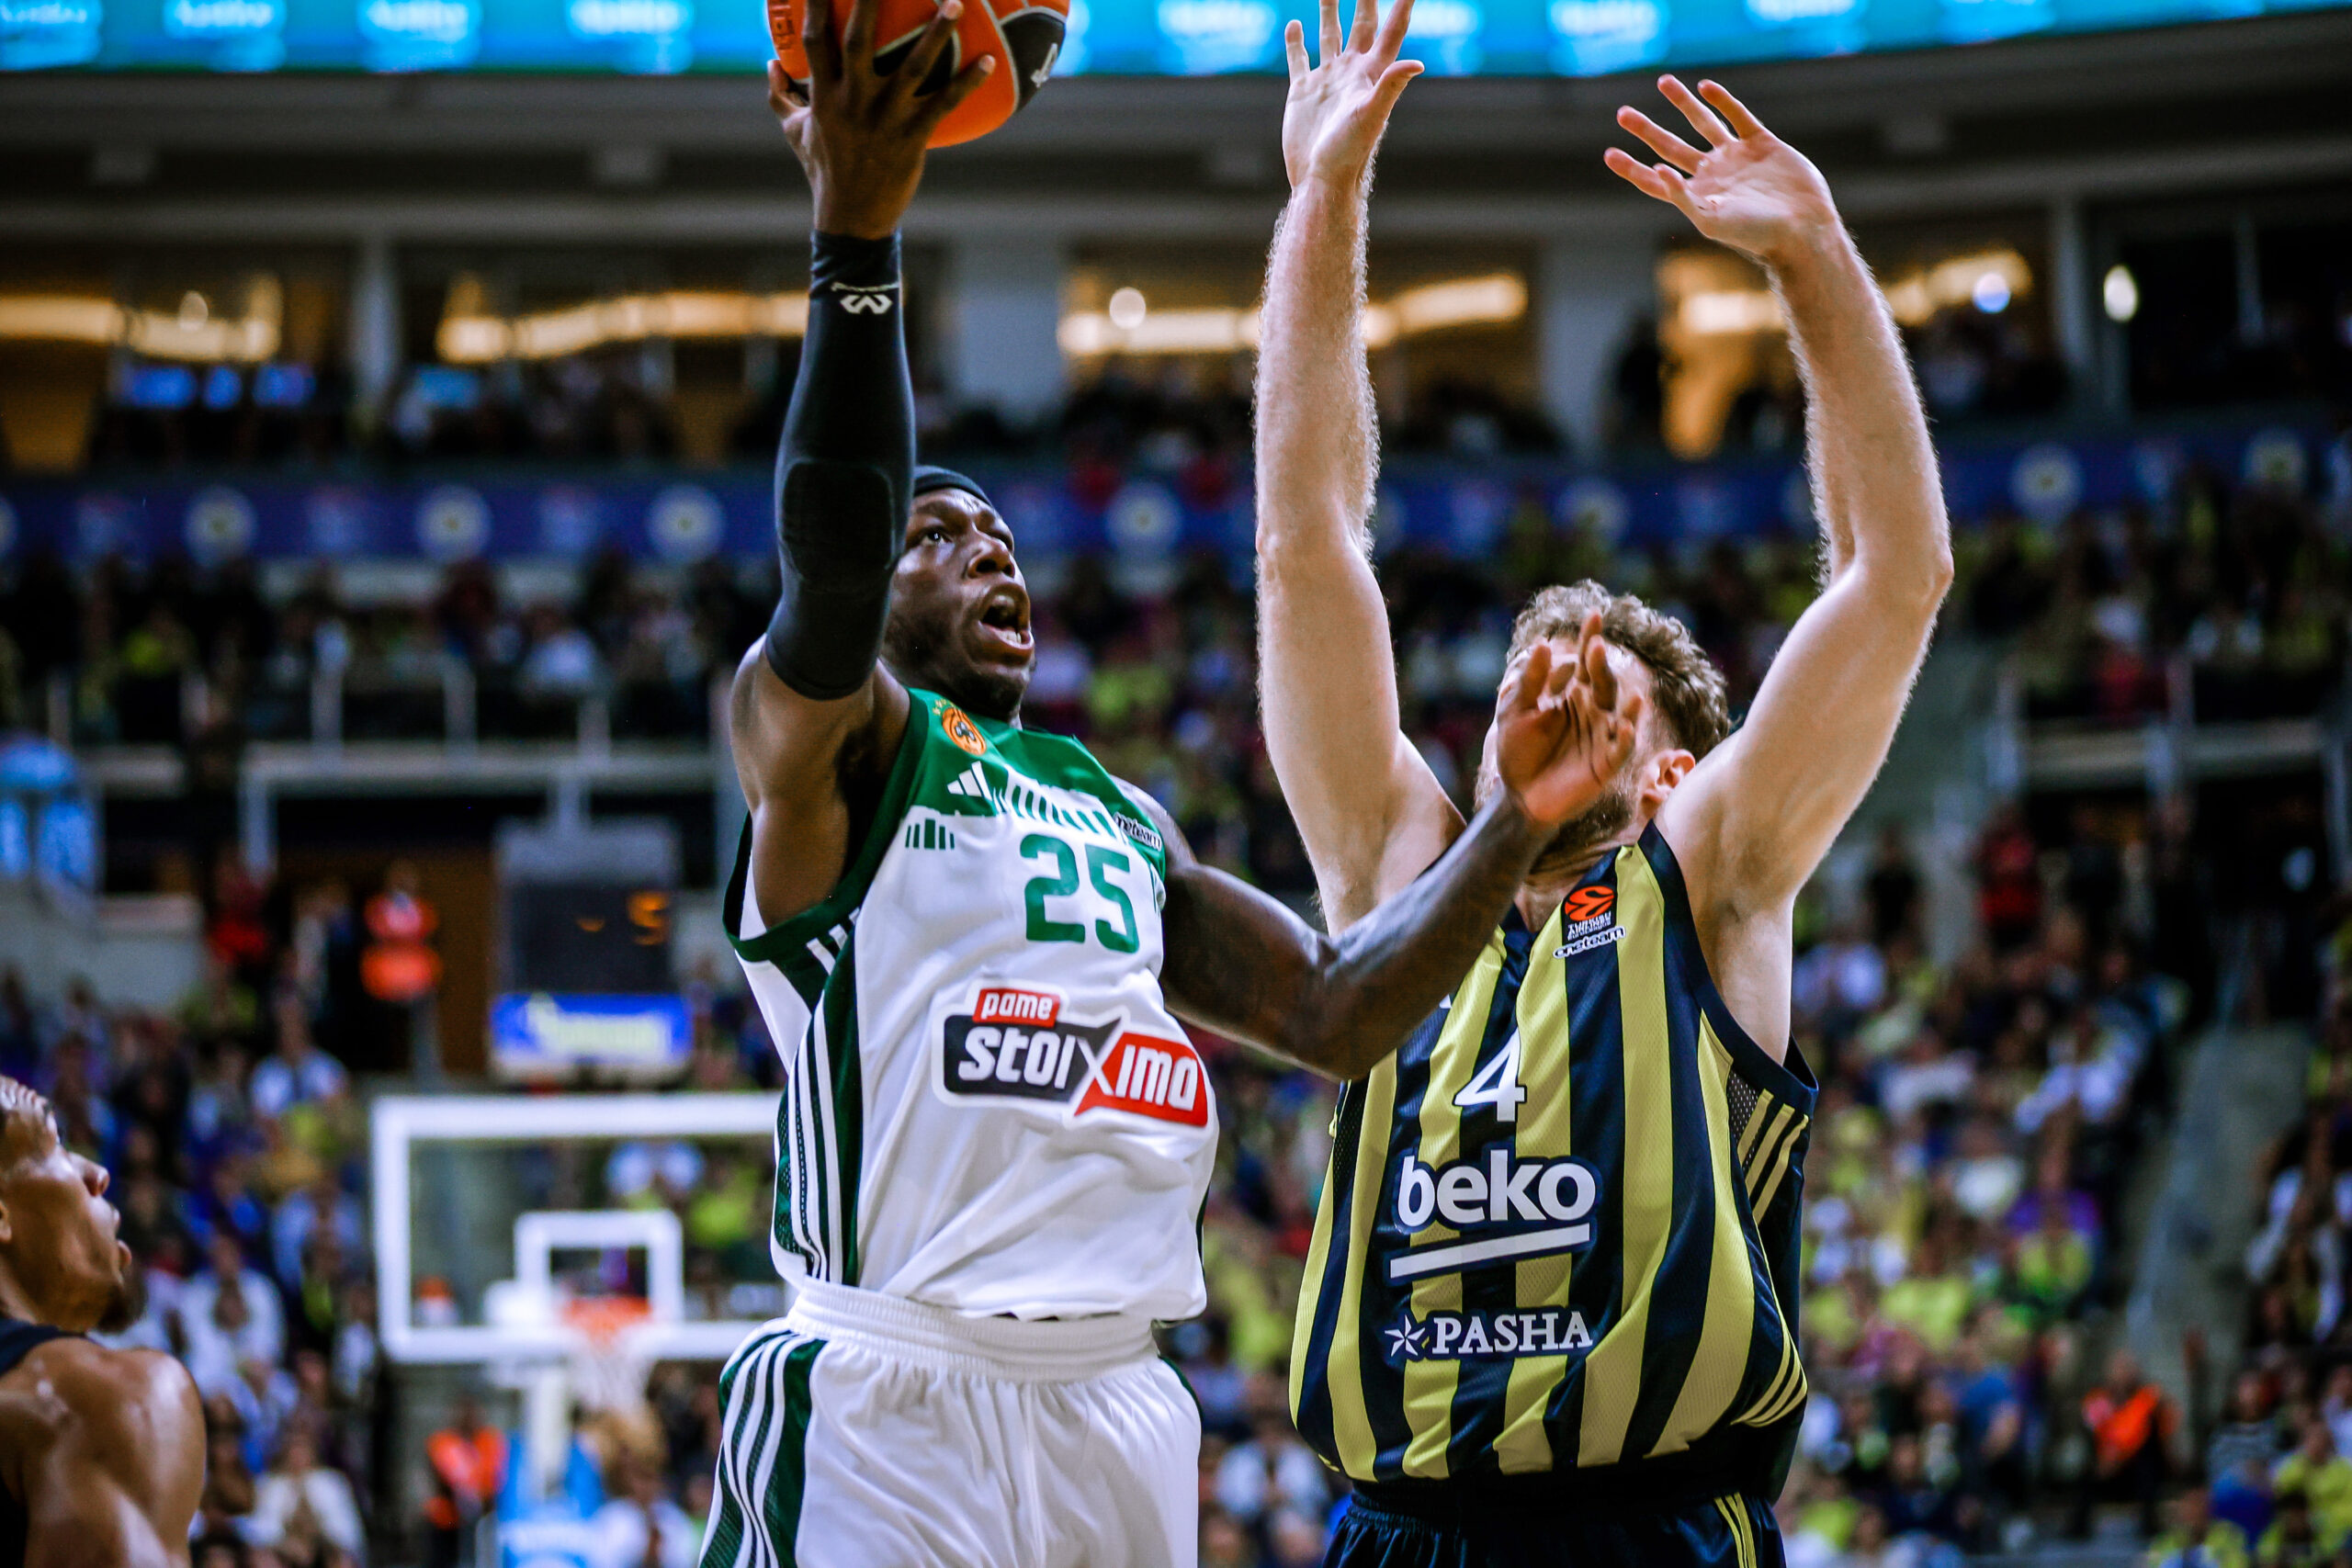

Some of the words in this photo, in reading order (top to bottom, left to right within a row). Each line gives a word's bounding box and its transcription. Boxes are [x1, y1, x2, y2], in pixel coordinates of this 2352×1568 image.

[1021, 833, 1140, 953] 25
[1553, 926, 1625, 959] oneteam
[981, 992, 1053, 1020] pame
[1454, 1028, 1525, 1122] 4
[1397, 1149, 1596, 1227] beko
[1431, 1311, 1594, 1355] PASHA
